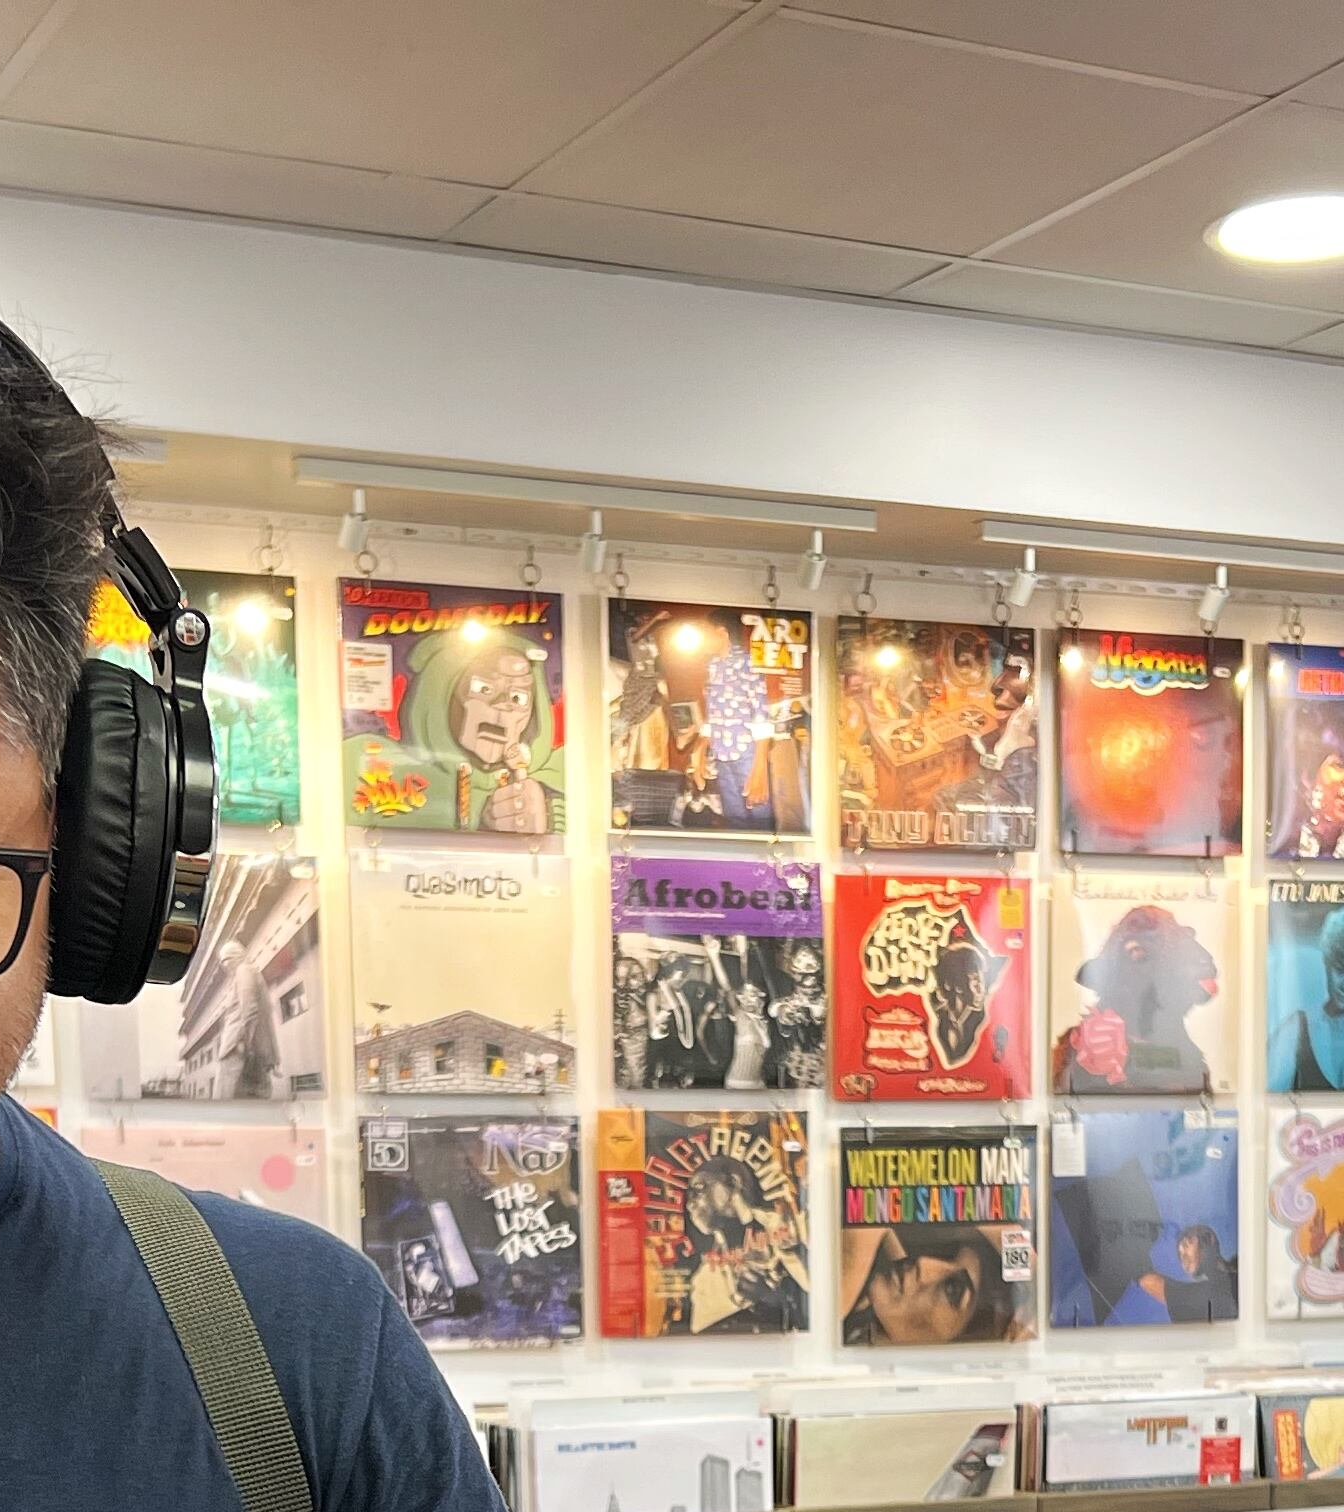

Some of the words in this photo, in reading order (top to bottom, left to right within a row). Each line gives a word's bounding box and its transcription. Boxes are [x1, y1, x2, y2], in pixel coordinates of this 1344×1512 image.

[624, 878, 814, 911] Afrobeat
[846, 1147, 977, 1186] WATERMELON
[980, 1146, 1030, 1185] MAN!
[484, 1181, 539, 1210] THE
[846, 1186, 914, 1223] MONGO
[915, 1184, 1032, 1222] SANTAMARIA
[494, 1200, 555, 1236] LOST
[496, 1222, 578, 1265] TAPES
